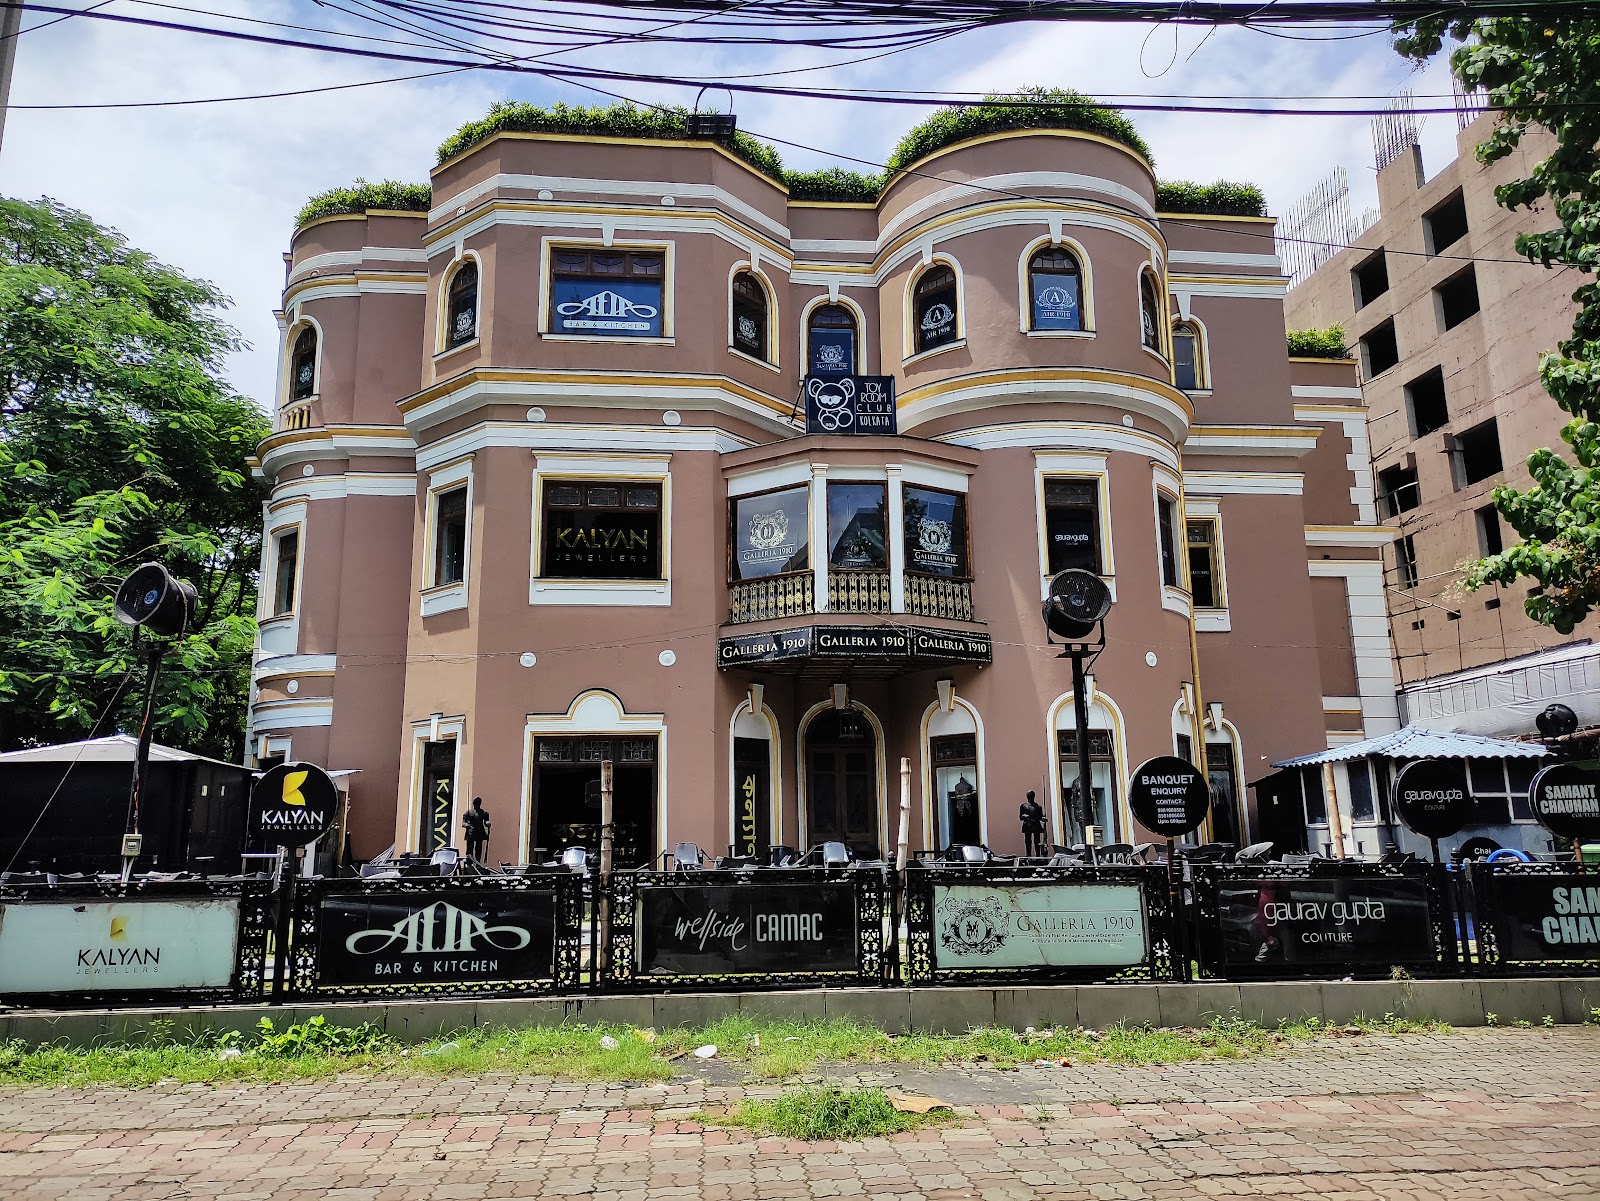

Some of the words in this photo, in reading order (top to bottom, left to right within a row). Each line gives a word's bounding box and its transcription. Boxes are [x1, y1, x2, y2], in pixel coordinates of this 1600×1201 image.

[926, 330, 938, 340] AIR
[864, 382, 882, 393] TOY
[860, 392, 887, 403] ROOM
[857, 404, 892, 412] CLUB
[859, 415, 890, 427] KOLKATA
[556, 527, 648, 550] KALYAN
[555, 553, 648, 562] JEWELLERS
[743, 550, 777, 560] GALLERIA
[779, 546, 793, 555] 1910
[914, 551, 944, 562] GALLERIA
[944, 555, 957, 564] 1910
[722, 642, 778, 658] GALLERIA
[782, 637, 806, 650] 1910
[819, 634, 878, 647] GALLERIA
[881, 636, 905, 647] 1910
[918, 635, 965, 651] GALLERIA
[967, 641, 987, 653] 1910
[1141, 774, 1195, 785] BANQUET
[1150, 787, 1187, 796] ENQUIRY
[1544, 784, 1596, 800] SAMANT
[1540, 798, 1600, 815] CHAUHAN
[261, 809, 324, 825] KALYAN
[433, 779, 450, 851] KALYA
[1263, 902, 1328, 927] gaurav
[1331, 897, 1386, 926] gupta
[756, 913, 823, 942] CAMAC
[1016, 915, 1096, 932] GALLERIA
[1103, 916, 1134, 930] 1910
[1301, 932, 1354, 943] COUTURE
[77, 947, 161, 967] KALYAN
[76, 966, 160, 975] JEWELLERS
[374, 962, 402, 975] BAR
[412, 962, 423, 974] &
[433, 959, 499, 973] KITCHEN
